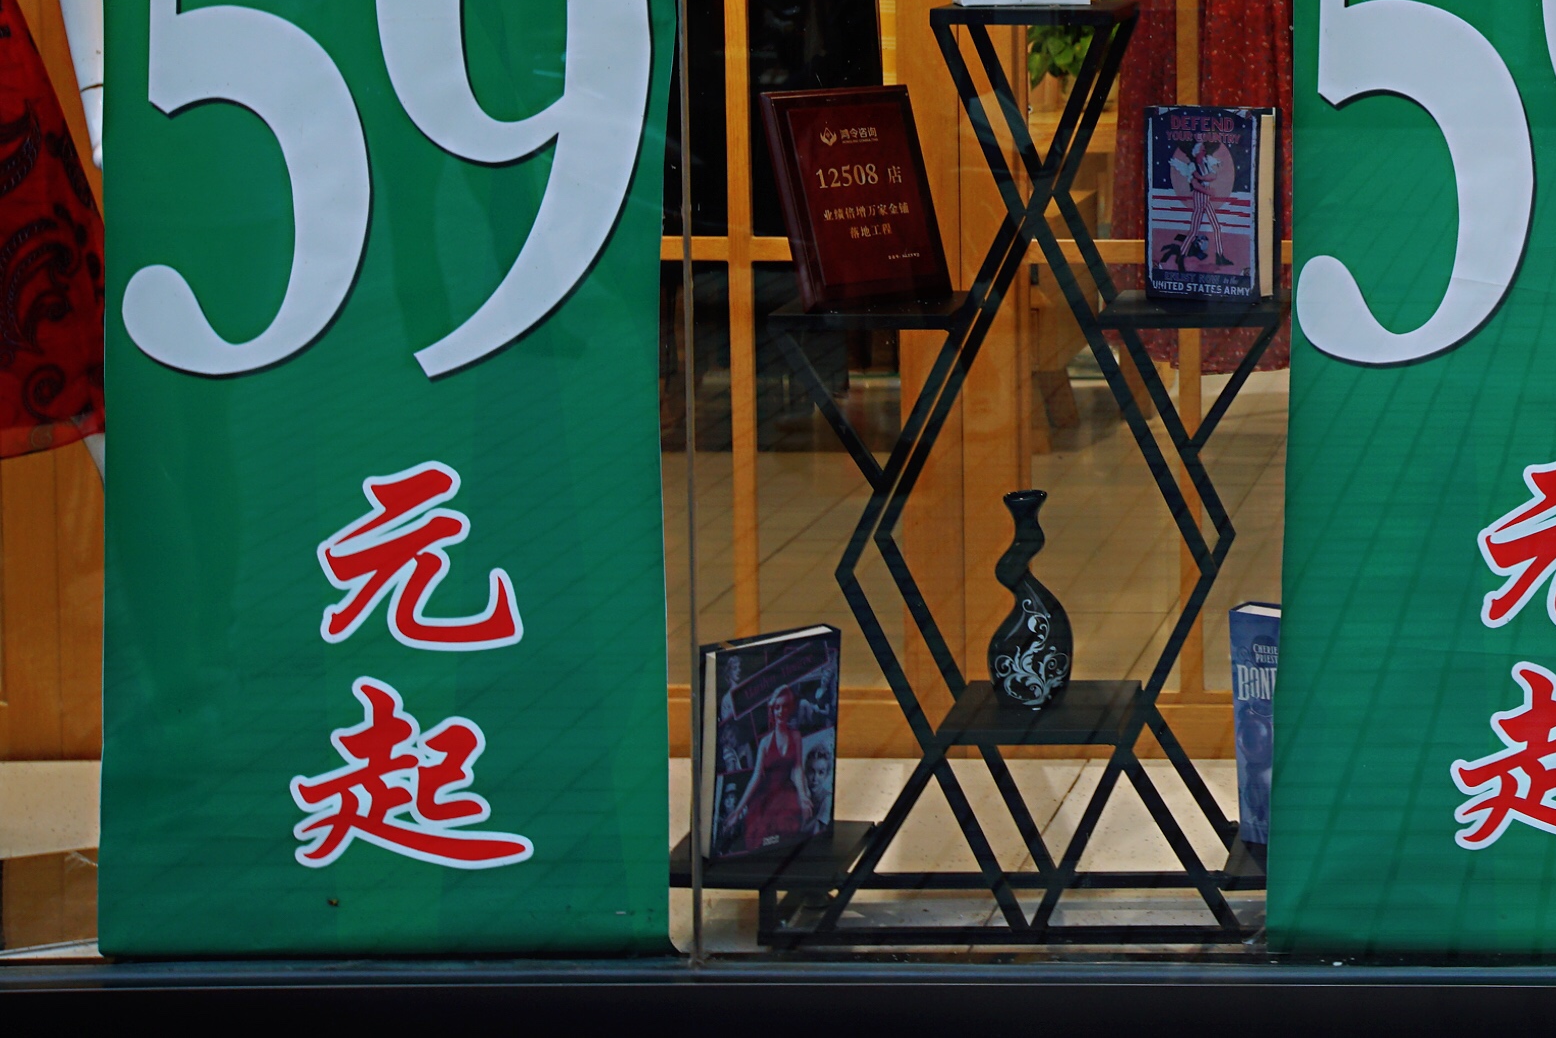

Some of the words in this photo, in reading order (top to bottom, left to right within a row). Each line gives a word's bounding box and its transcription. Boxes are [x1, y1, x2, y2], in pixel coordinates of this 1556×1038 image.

[1170, 115, 1235, 133] DEFEND
[1166, 130, 1194, 142] YOUR
[1193, 131, 1242, 145] COUNTRY
[815, 163, 879, 189] 12508
[887, 165, 902, 185] 店
[1152, 280, 1185, 292] UNITED
[1186, 282, 1222, 294] STATES
[1223, 286, 1251, 297] ARMY
[1253, 643, 1279, 655] CHERIE
[290, 459, 532, 871] 元起
[1255, 653, 1279, 664] PRIEST
